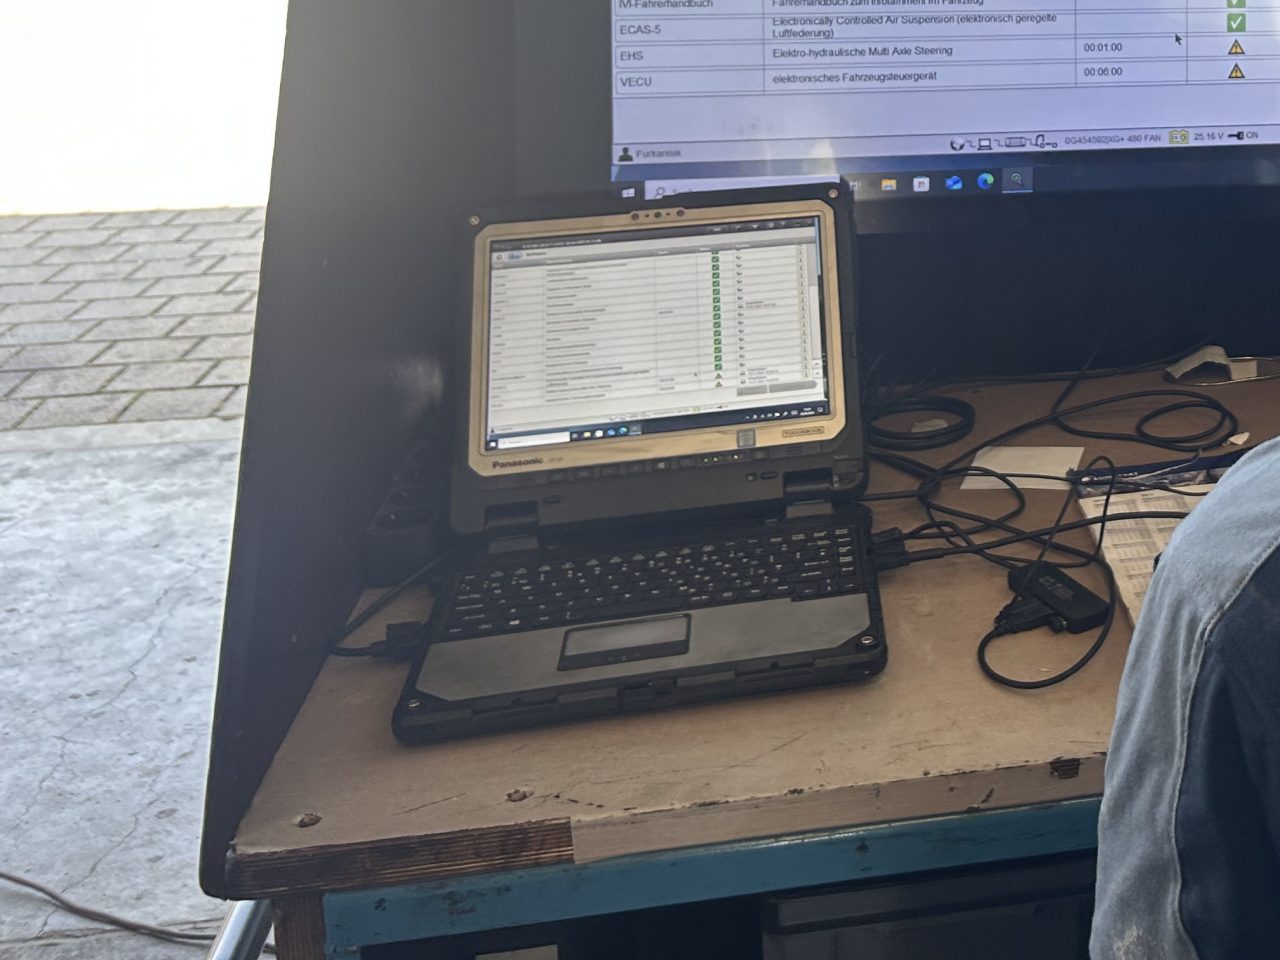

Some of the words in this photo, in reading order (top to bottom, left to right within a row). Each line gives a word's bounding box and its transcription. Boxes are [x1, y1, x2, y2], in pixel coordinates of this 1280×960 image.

[772, 15, 833, 28] Electronically
[835, 15, 883, 26] Controlled
[884, 15, 899, 25] Air
[900, 14, 955, 26] Suspension
[956, 13, 1014, 25] (elektronisch
[1015, 13, 1057, 25] geregelte
[619, 24, 662, 35] ECAS-5
[772, 28, 834, 39] Luftfederung)
[772, 46, 866, 59] Elektro-hydraulische
[868, 46, 890, 57] Multi
[891, 46, 912, 56] Axle
[914, 45, 953, 58] Steering
[1083, 42, 1123, 52] 00:01:00
[619, 50, 644, 61] EHS
[620, 76, 652, 87] VECU
[772, 73, 840, 84] elektronisches
[842, 71, 937, 83] Fahrzeugsteuergerät
[492, 456, 544, 469] Panasonic
